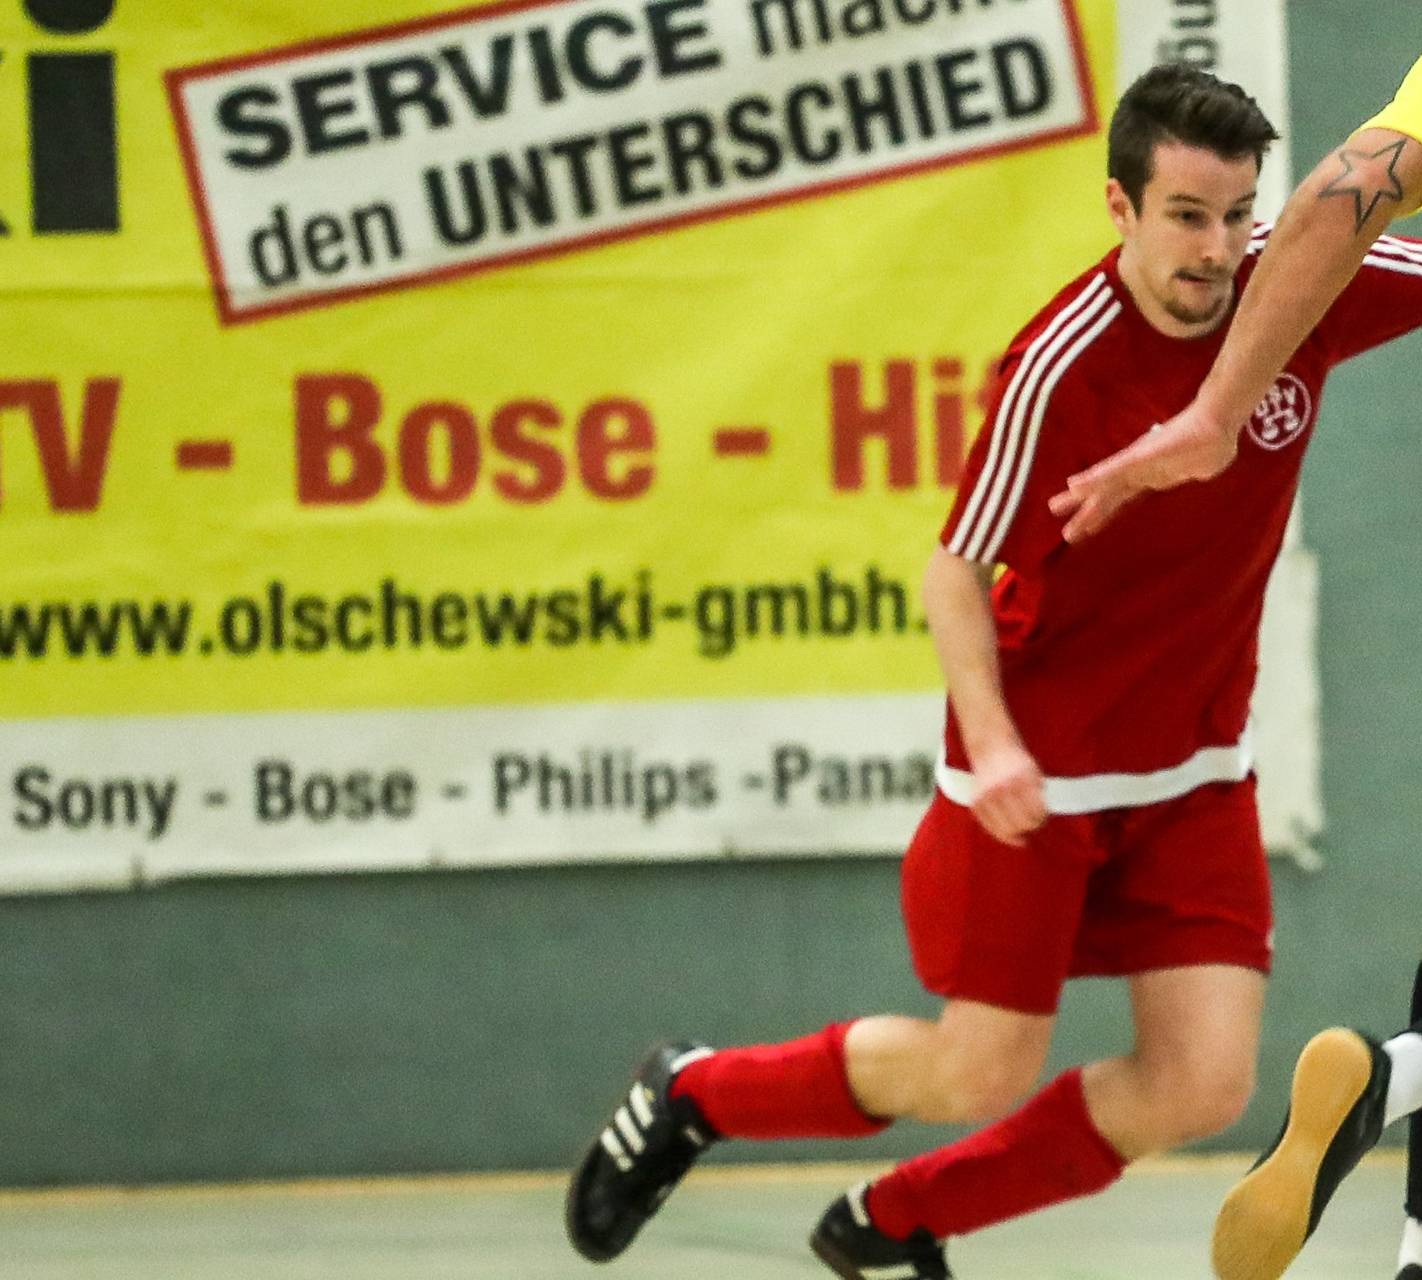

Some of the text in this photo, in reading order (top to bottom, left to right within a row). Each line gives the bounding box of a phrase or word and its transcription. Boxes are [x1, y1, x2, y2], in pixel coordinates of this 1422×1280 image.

[215, 0, 721, 171] SERVICE
[247, 36, 1056, 289] den UNTERSCHIED
[293, 370, 656, 507] Bose
[12, 762, 178, 839] Sony
[253, 758, 418, 824] Bose
[493, 748, 718, 826] Philips
